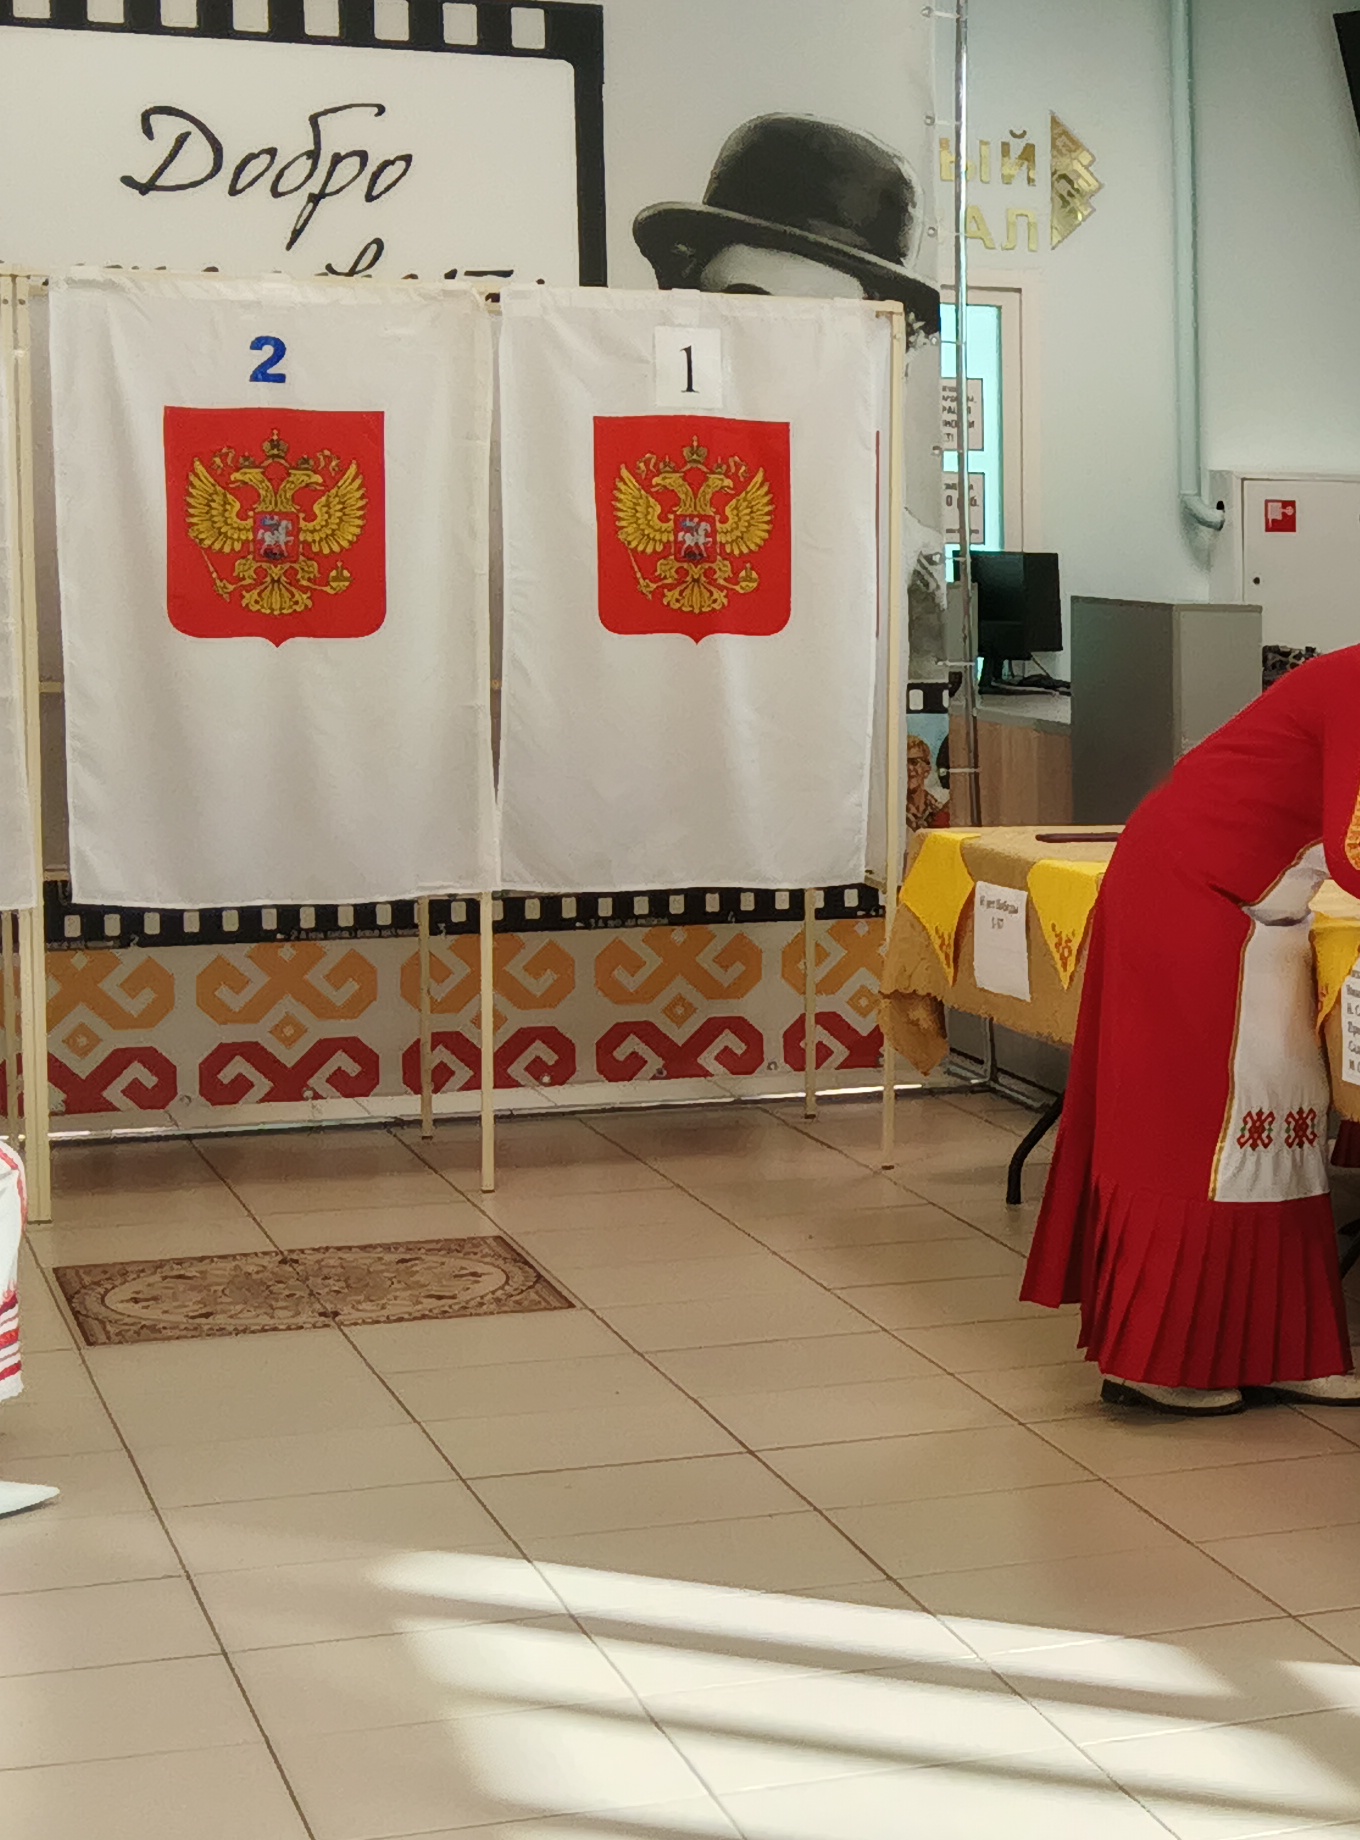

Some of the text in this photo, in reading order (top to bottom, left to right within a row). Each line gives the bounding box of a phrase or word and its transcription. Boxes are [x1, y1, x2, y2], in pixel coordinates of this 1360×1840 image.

[119, 103, 414, 251] Добро
[249, 335, 287, 384] 2
[679, 343, 700, 394] 1
